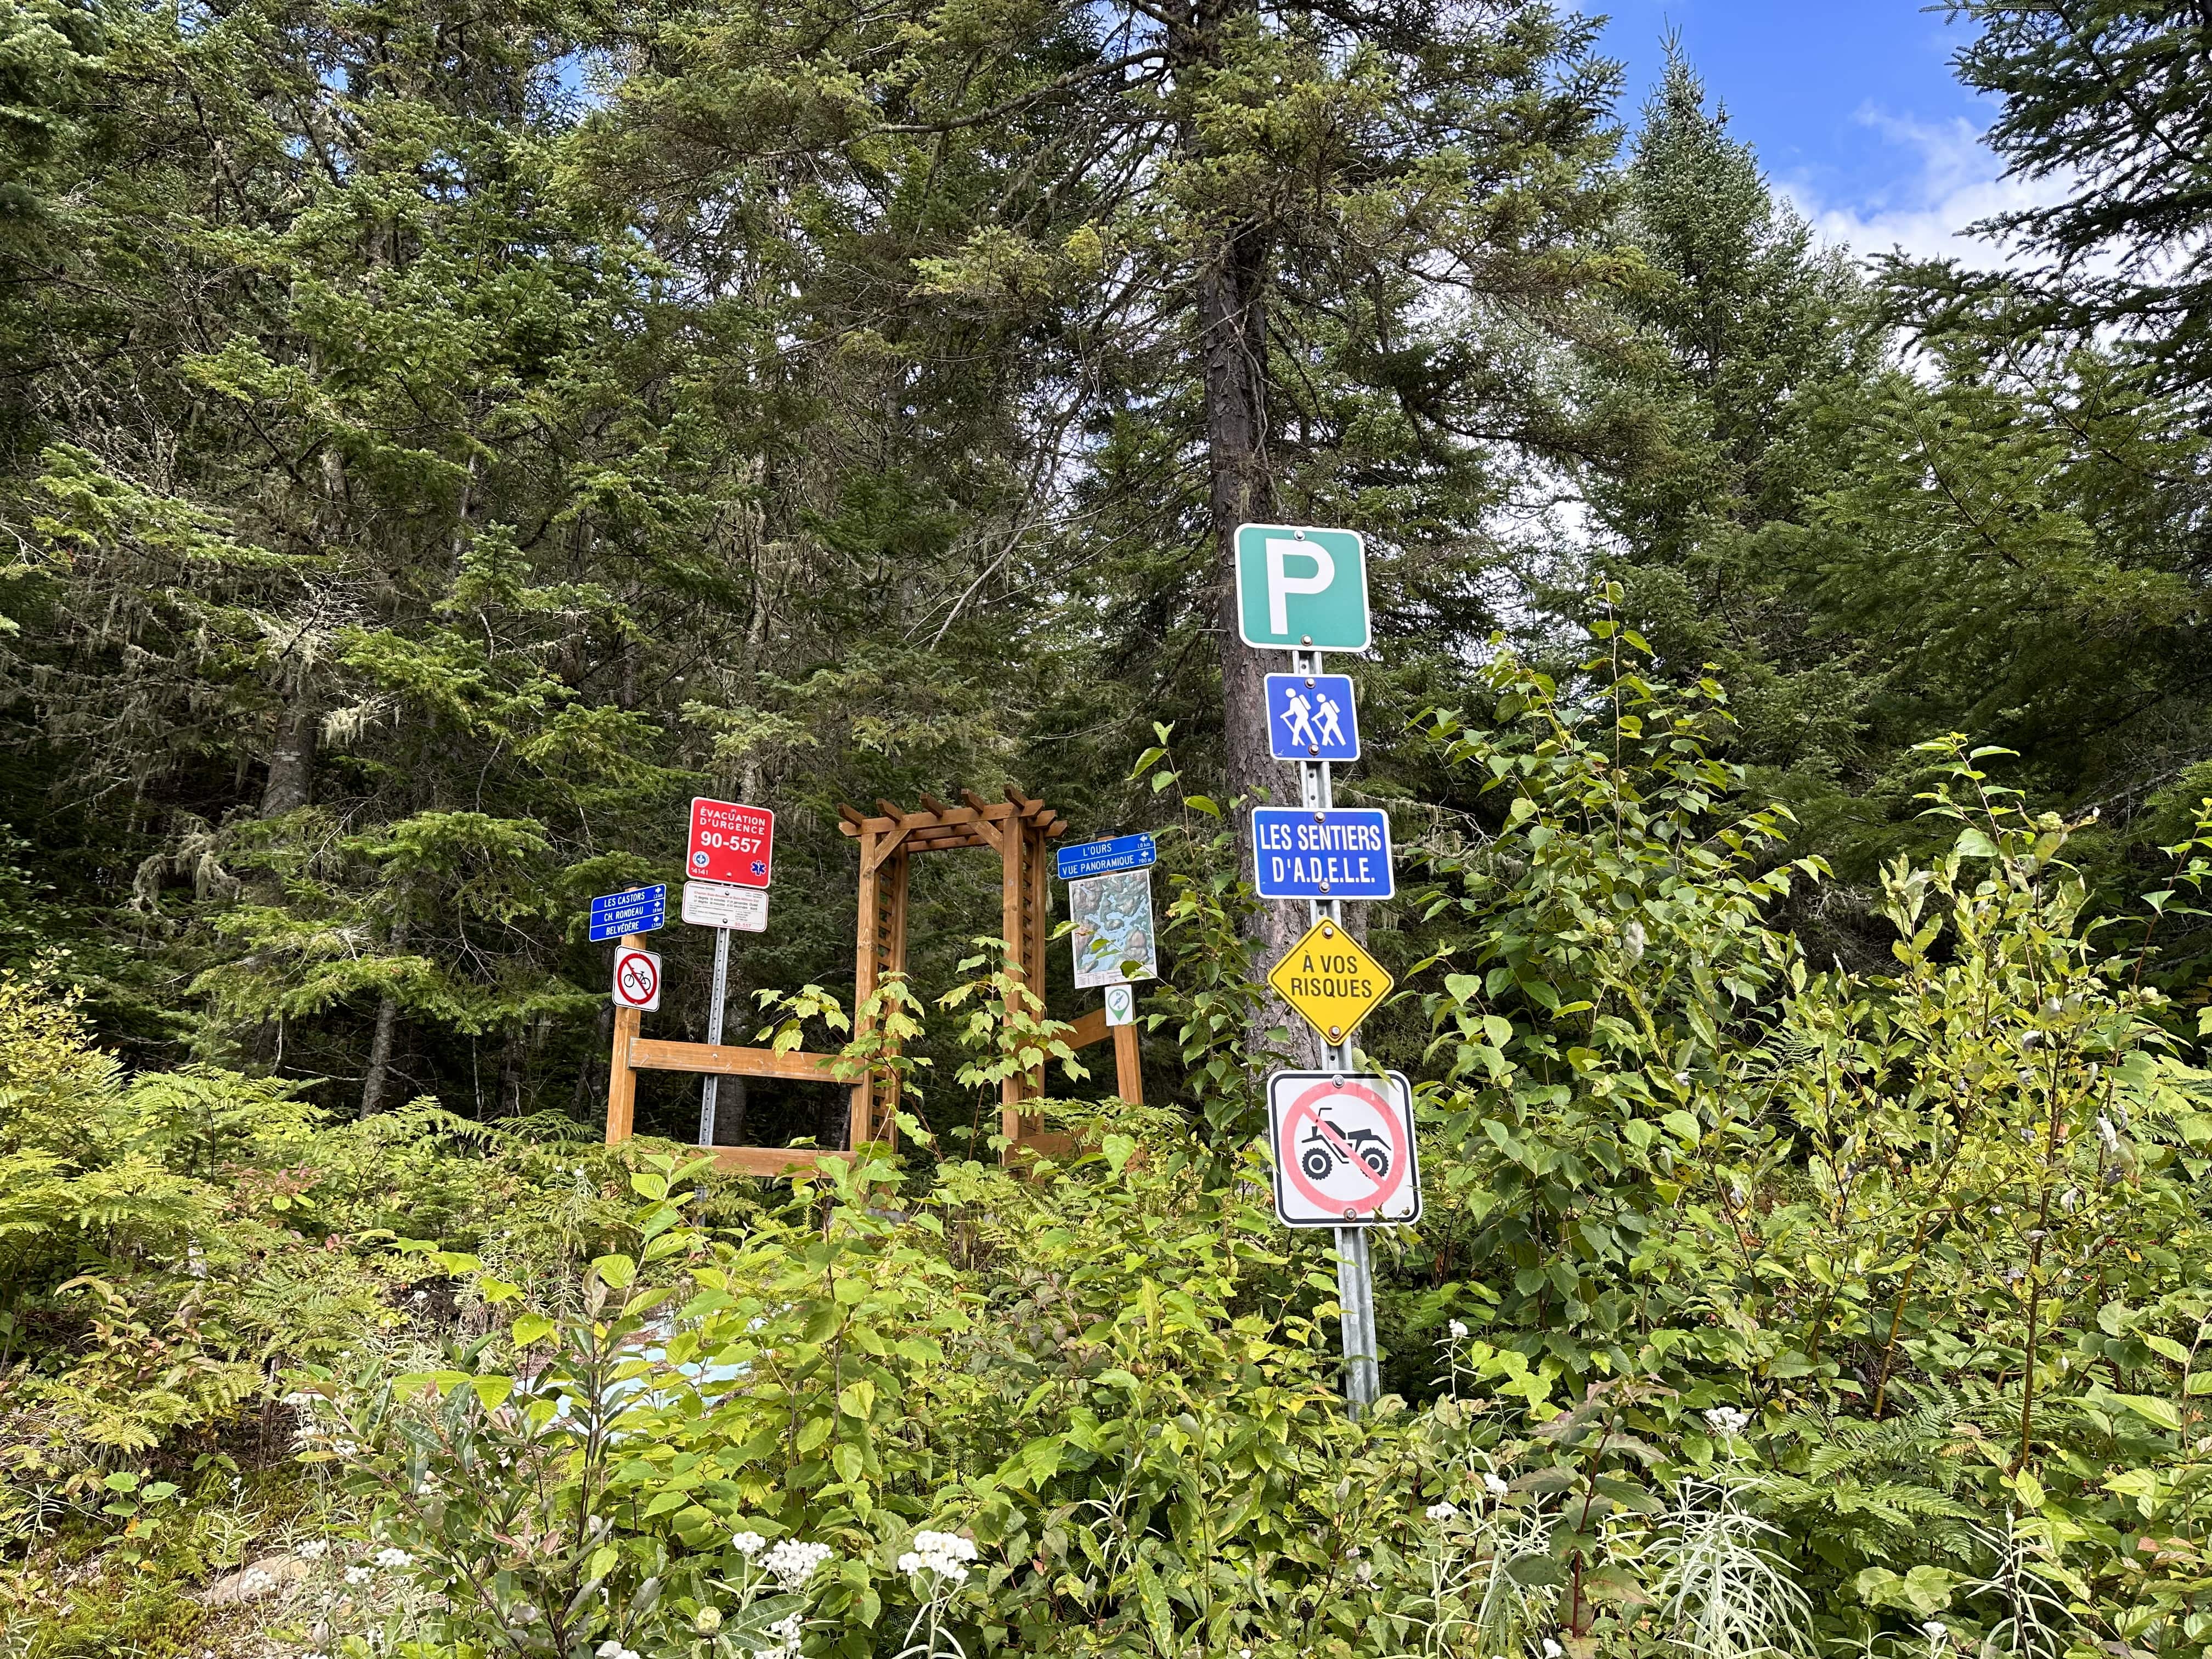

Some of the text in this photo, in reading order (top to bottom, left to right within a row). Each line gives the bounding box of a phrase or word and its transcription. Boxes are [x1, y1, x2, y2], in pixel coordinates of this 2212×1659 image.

[1265, 538, 1335, 635] P
[700, 806, 765, 826] ÉVACUATION
[699, 817, 765, 836] D'URGENCE
[701, 831, 761, 854] 90-557
[1260, 824, 1381, 851] LES SENTIERS
[1083, 843, 1111, 856] L'OURS
[1062, 865, 1078, 876] VUE
[1081, 855, 1135, 872] PANORAMIQUE
[1272, 856, 1375, 883] D'A.D.E.L.E.
[604, 898, 616, 907] LES
[618, 891, 645, 905] CASTORS
[604, 913, 613, 922] CH.
[616, 906, 644, 919] RONDEAU
[606, 921, 639, 935] BELVÉDÈRE
[1302, 950, 1357, 974] À VOS
[1291, 978, 1372, 998] RISQUES
